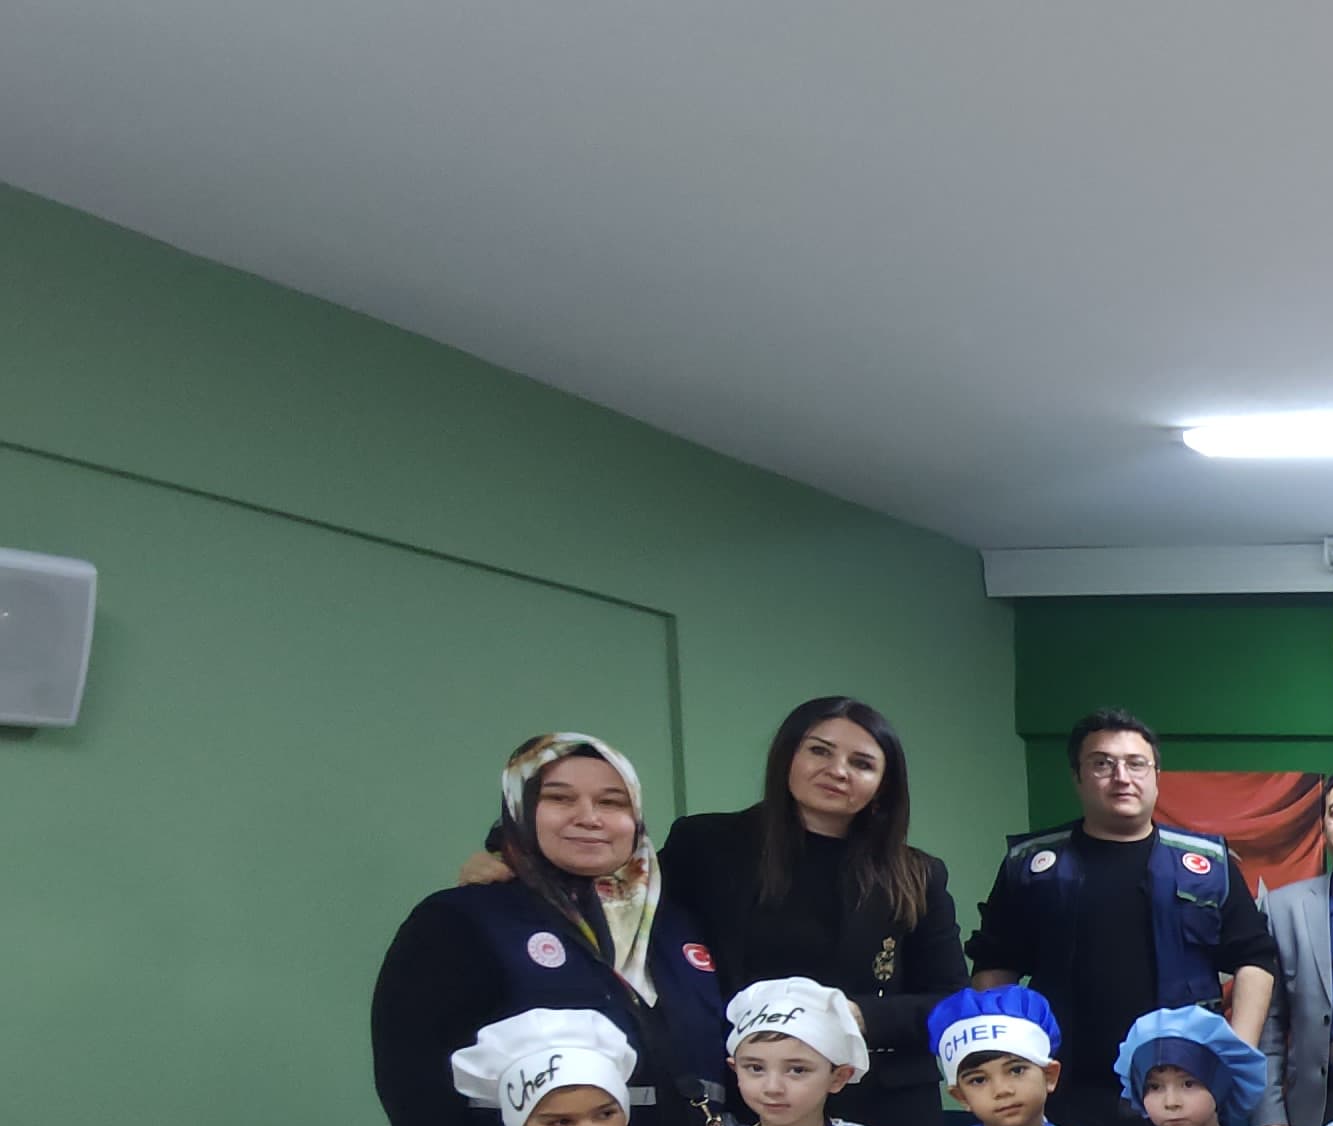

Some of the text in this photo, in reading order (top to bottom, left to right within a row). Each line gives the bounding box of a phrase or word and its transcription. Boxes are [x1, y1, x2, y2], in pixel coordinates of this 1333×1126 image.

[737, 1004, 805, 1035] Chef
[944, 1024, 1008, 1062] CHEF
[507, 1054, 563, 1111] Chef
